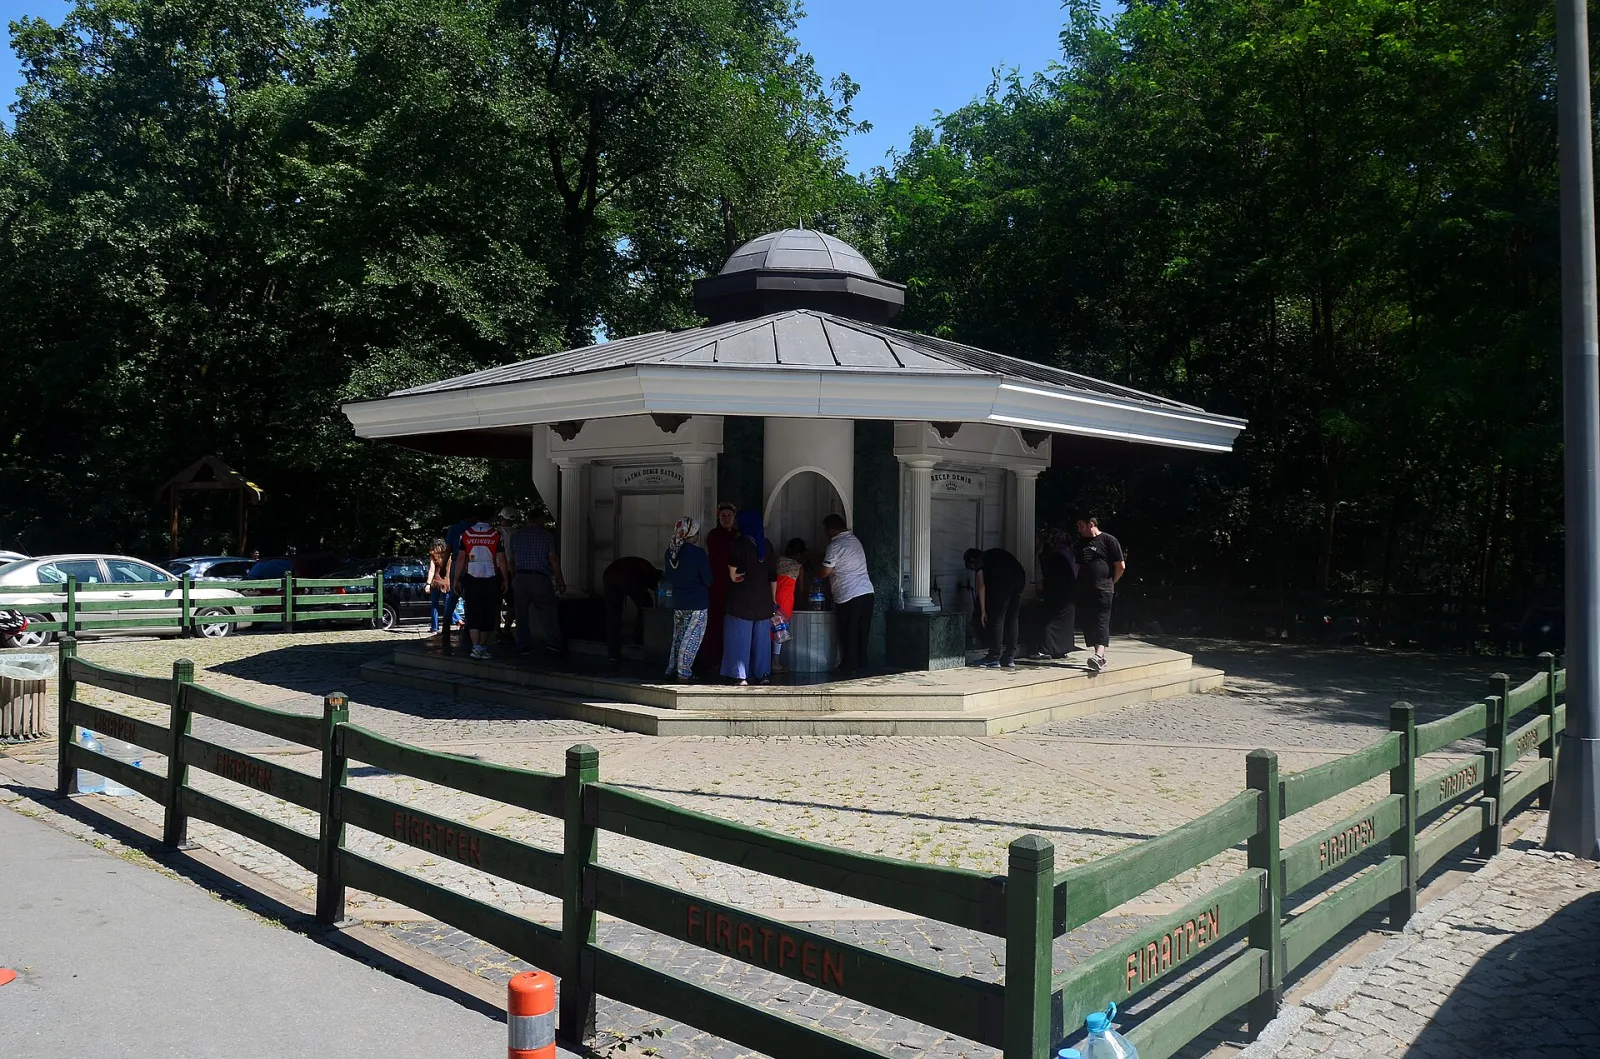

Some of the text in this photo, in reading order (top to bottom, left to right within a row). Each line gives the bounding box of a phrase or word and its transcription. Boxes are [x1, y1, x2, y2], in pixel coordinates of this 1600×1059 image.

[931, 473, 950, 482] RECEP
[393, 811, 481, 865] FIRATPEN
[1320, 815, 1375, 871] FIRATPEN
[687, 904, 845, 989] FIRATPEN
[1126, 903, 1219, 994] FIRATPEN
